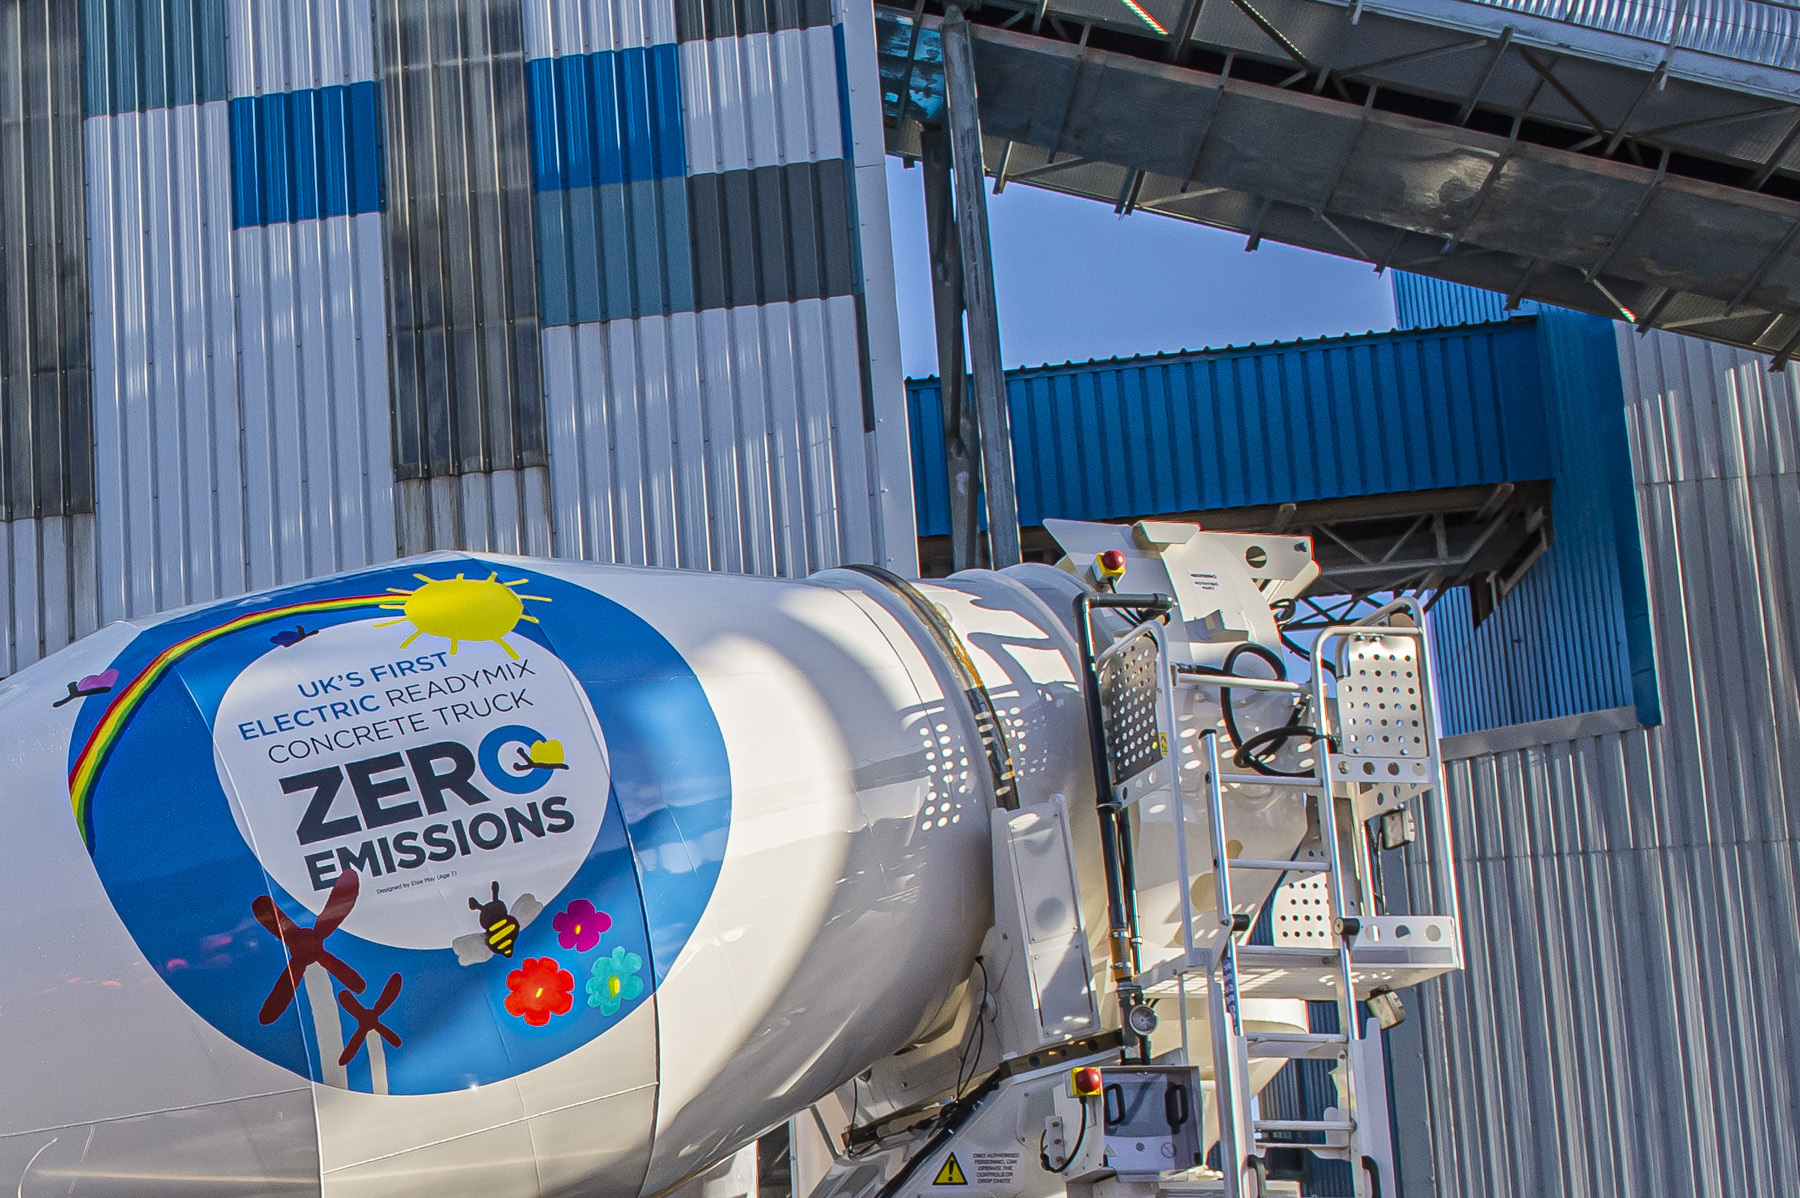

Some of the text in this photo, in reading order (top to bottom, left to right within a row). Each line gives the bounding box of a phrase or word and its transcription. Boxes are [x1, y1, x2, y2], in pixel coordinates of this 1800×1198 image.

[237, 659, 536, 741] ELECTRIC READYMIX
[298, 652, 448, 698] UK'S FIRST
[267, 688, 534, 764] CONCRETE TRUCK
[278, 724, 556, 846] ZERO
[303, 796, 575, 892] EMISSIONS
[376, 884, 403, 895] Designed
[410, 879, 424, 887] Elsie
